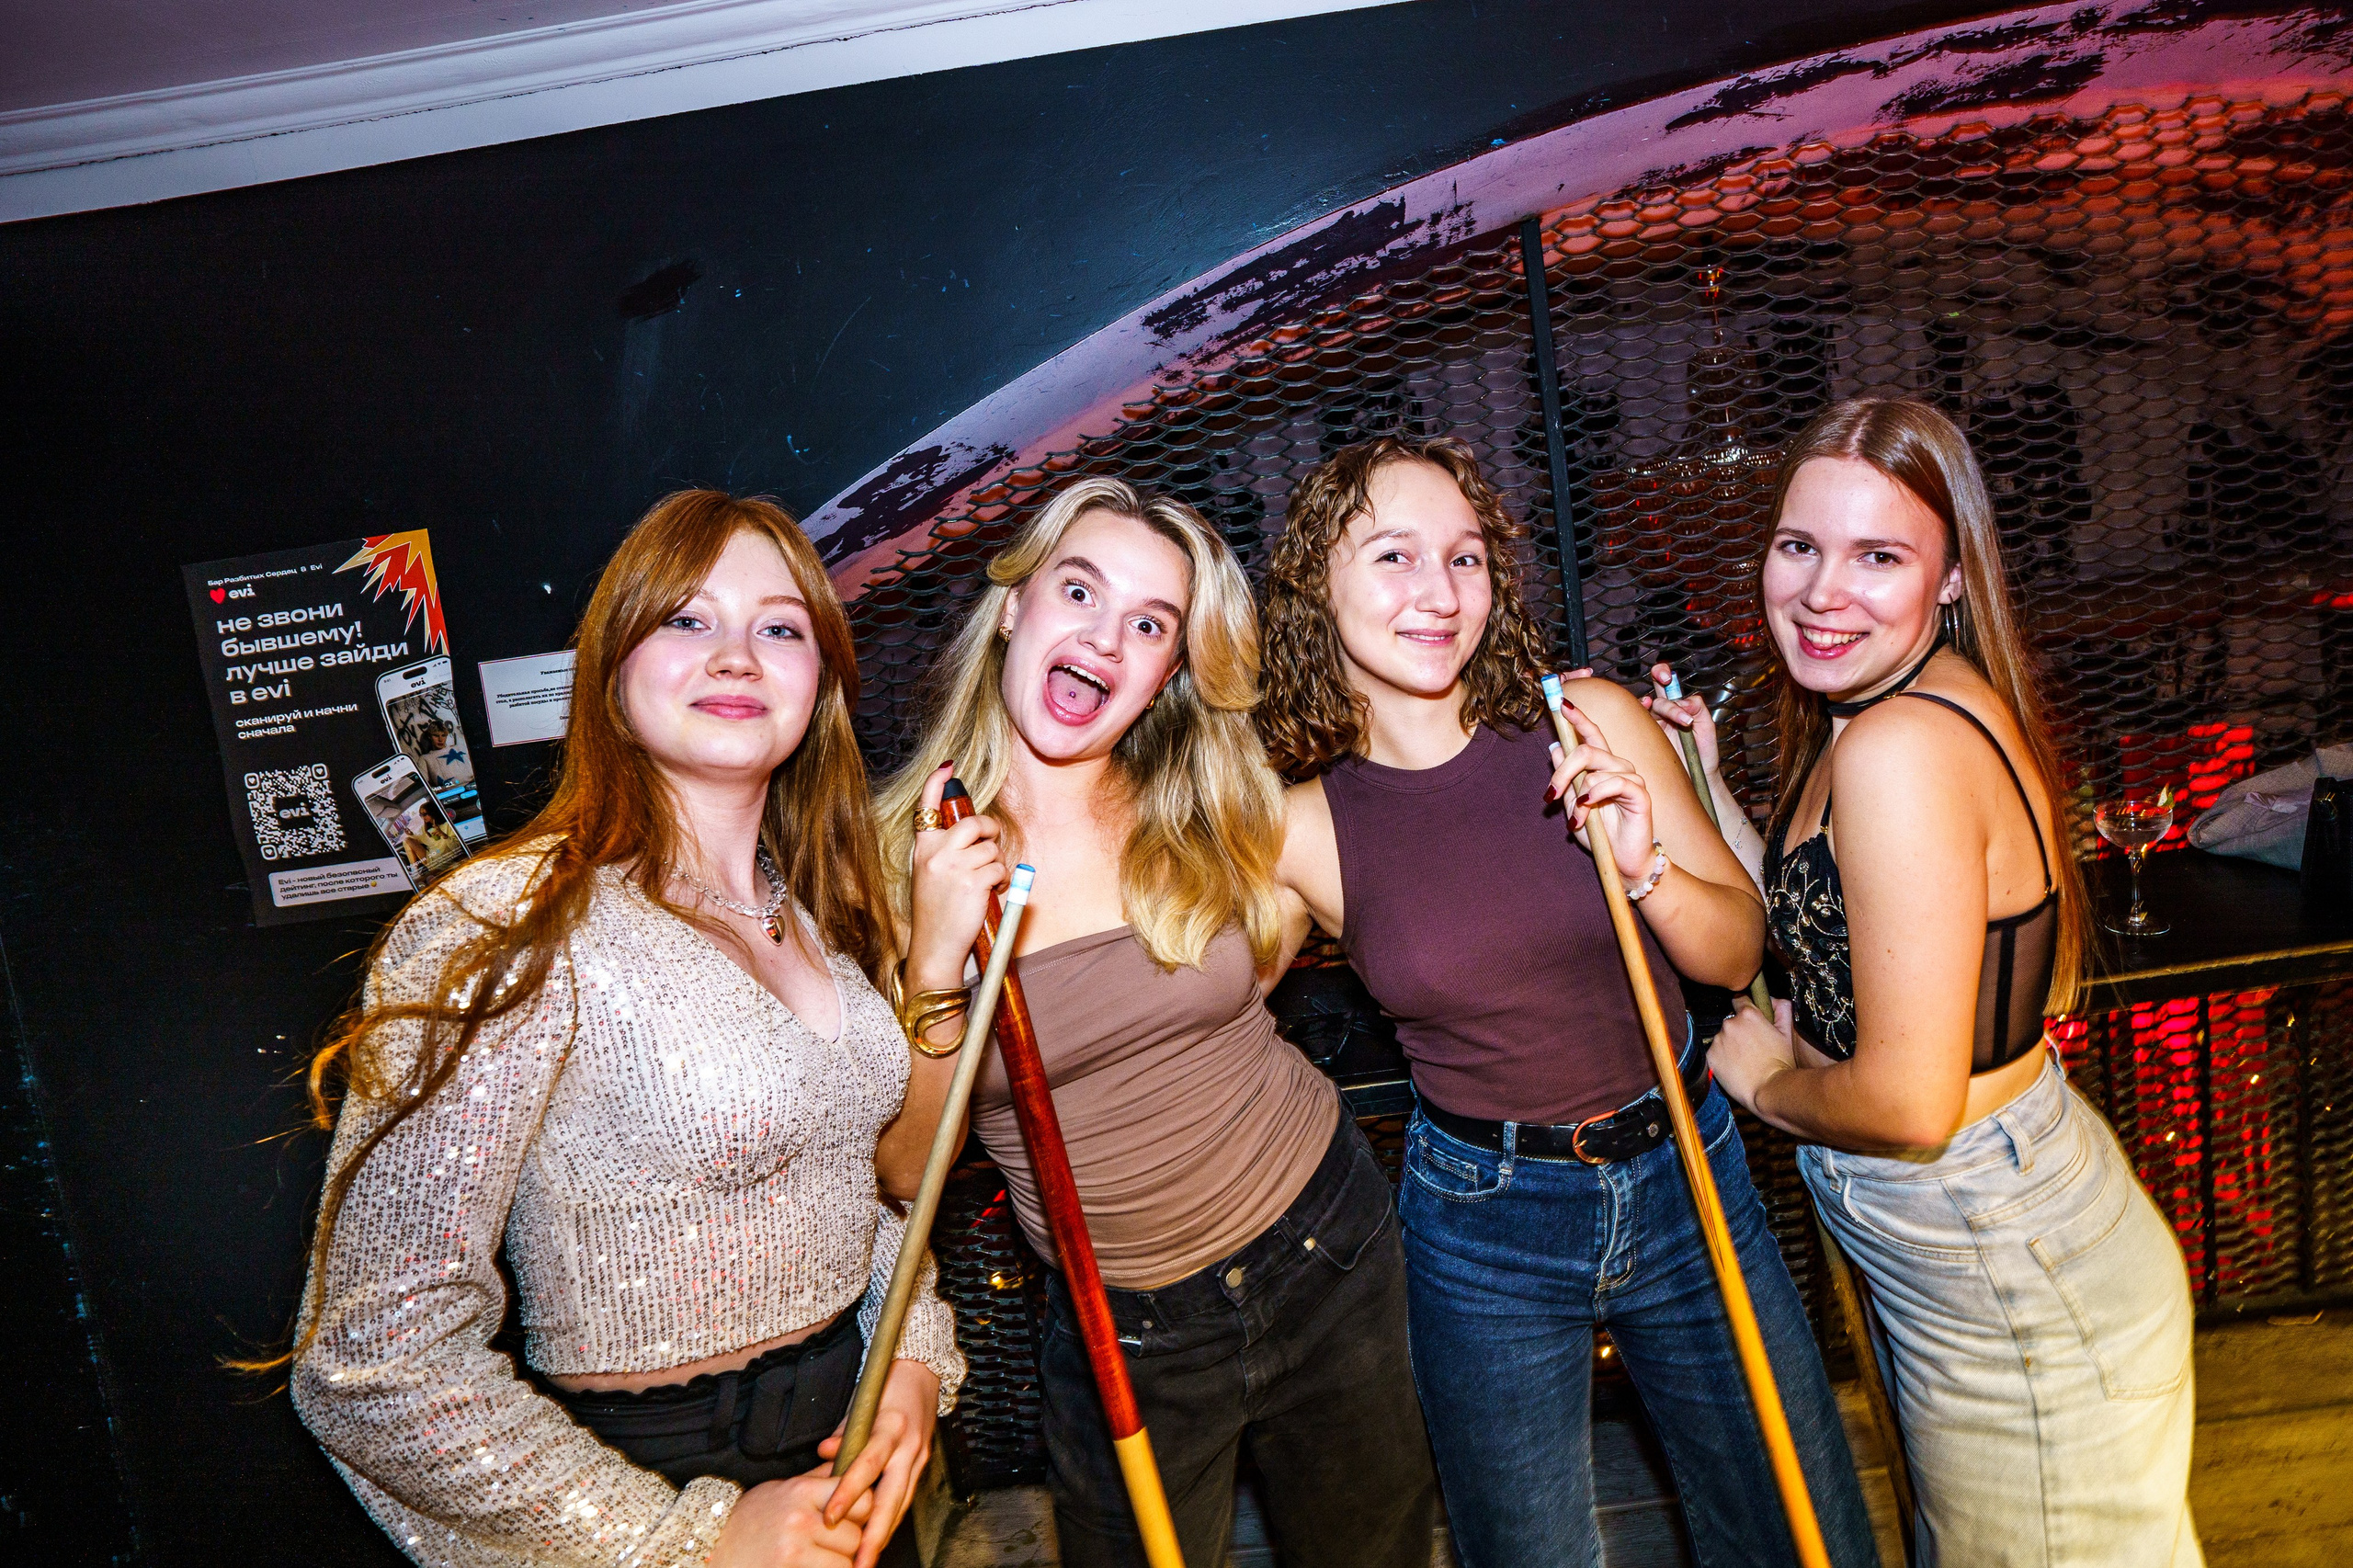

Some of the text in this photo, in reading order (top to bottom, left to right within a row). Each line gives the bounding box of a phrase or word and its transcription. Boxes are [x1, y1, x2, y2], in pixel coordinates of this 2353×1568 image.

[224, 573, 265, 584] Разбитых
[265, 568, 298, 578] Сердец
[228, 583, 256, 599] evi
[216, 603, 345, 634] не звони
[221, 621, 363, 658] бывшему!
[225, 642, 409, 684] лучше зайди
[410, 676, 426, 688] evi
[229, 678, 292, 705] в evi
[235, 703, 359, 728] сканируй и начни
[237, 724, 296, 740] сначала
[380, 774, 392, 784] evi
[278, 801, 311, 819] evi
[297, 874, 325, 882] новый
[326, 867, 381, 879] безопасный
[318, 880, 344, 888] после
[346, 874, 385, 882] которого
[281, 891, 319, 901] удалишь
[337, 883, 369, 892] старые
